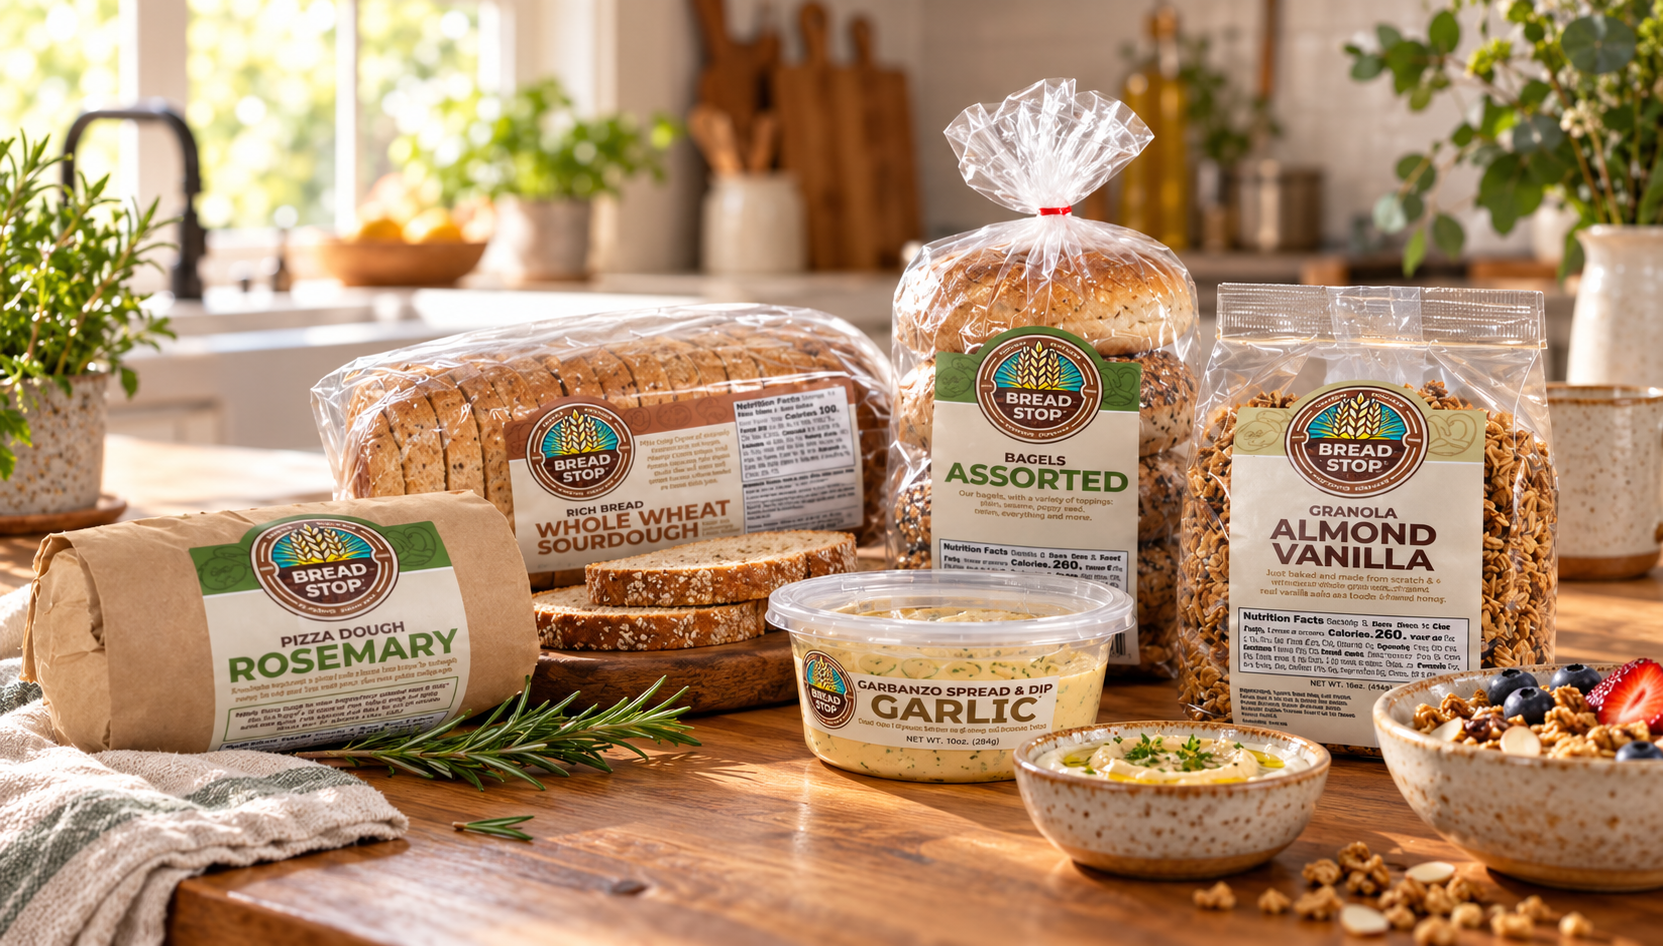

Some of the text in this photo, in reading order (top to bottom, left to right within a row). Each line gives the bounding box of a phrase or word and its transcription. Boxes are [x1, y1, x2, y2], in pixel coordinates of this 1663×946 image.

[1006, 392, 1072, 407] BREAD
[1013, 407, 1063, 421] STOP
[1318, 443, 1393, 458] BREAD
[553, 453, 612, 472] BREAD
[1004, 452, 1066, 466] BAGELS
[1326, 458, 1382, 473] STOP
[562, 467, 606, 483] STOP
[944, 462, 1129, 493] ASSORTED
[959, 490, 974, 498] Our
[1008, 493, 1026, 501] with
[1065, 496, 1075, 504] of
[1076, 496, 1114, 506] toppings:
[566, 500, 644, 517] RICH BREAD
[1309, 504, 1398, 519] GRANOLA
[535, 511, 631, 538] WHOLE
[638, 499, 731, 526] WHEAT
[537, 522, 699, 556] SOURDOUGH
[1269, 518, 1437, 546] ALMOND
[943, 542, 981, 554] Nutrition
[984, 546, 1008, 556] Facts
[1272, 543, 1435, 572] VANILLA
[291, 563, 367, 584] BREAD
[1288, 570, 1316, 579] baked
[1319, 572, 1336, 580] and
[1338, 573, 1364, 582] made
[1366, 574, 1389, 583] from
[1390, 576, 1424, 584] scratch
[305, 579, 362, 598] STOP
[1243, 612, 1291, 623] Nutrition
[1293, 615, 1324, 625] Facts
[280, 621, 405, 648] PIZZA DOUGH
[228, 628, 458, 683] ROSEMARY
[857, 680, 1053, 697] GARBANZO SPREAD & DIP
[1310, 680, 1327, 688] NET
[815, 700, 837, 714] STOP
[871, 694, 1038, 724] GARLIC
[906, 735, 923, 743] NET
